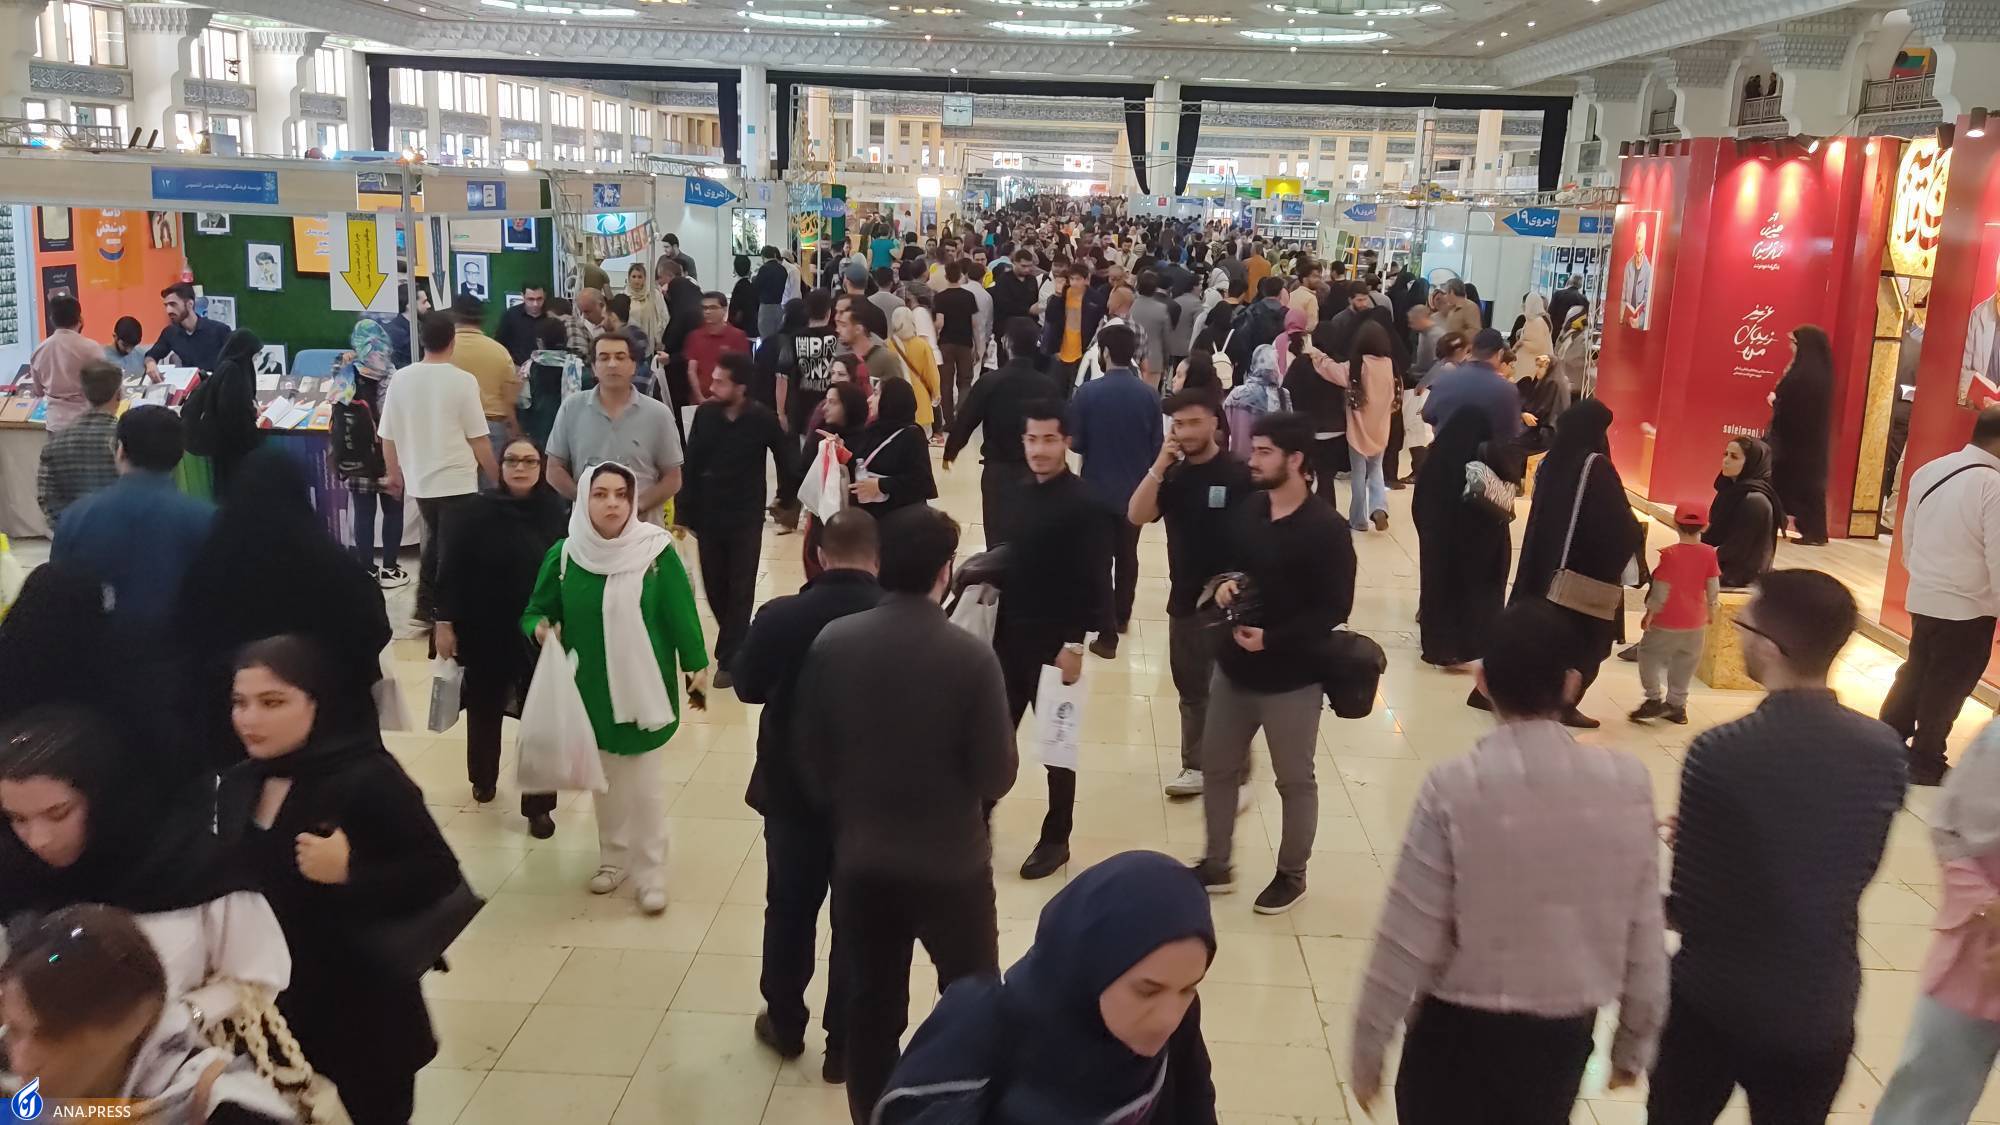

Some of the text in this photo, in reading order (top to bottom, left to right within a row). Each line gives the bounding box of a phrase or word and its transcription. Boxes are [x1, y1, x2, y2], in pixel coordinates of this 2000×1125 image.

[690, 181, 730, 201] راهروی ۱۹
[1516, 209, 1557, 228] راهروی ۱۹
